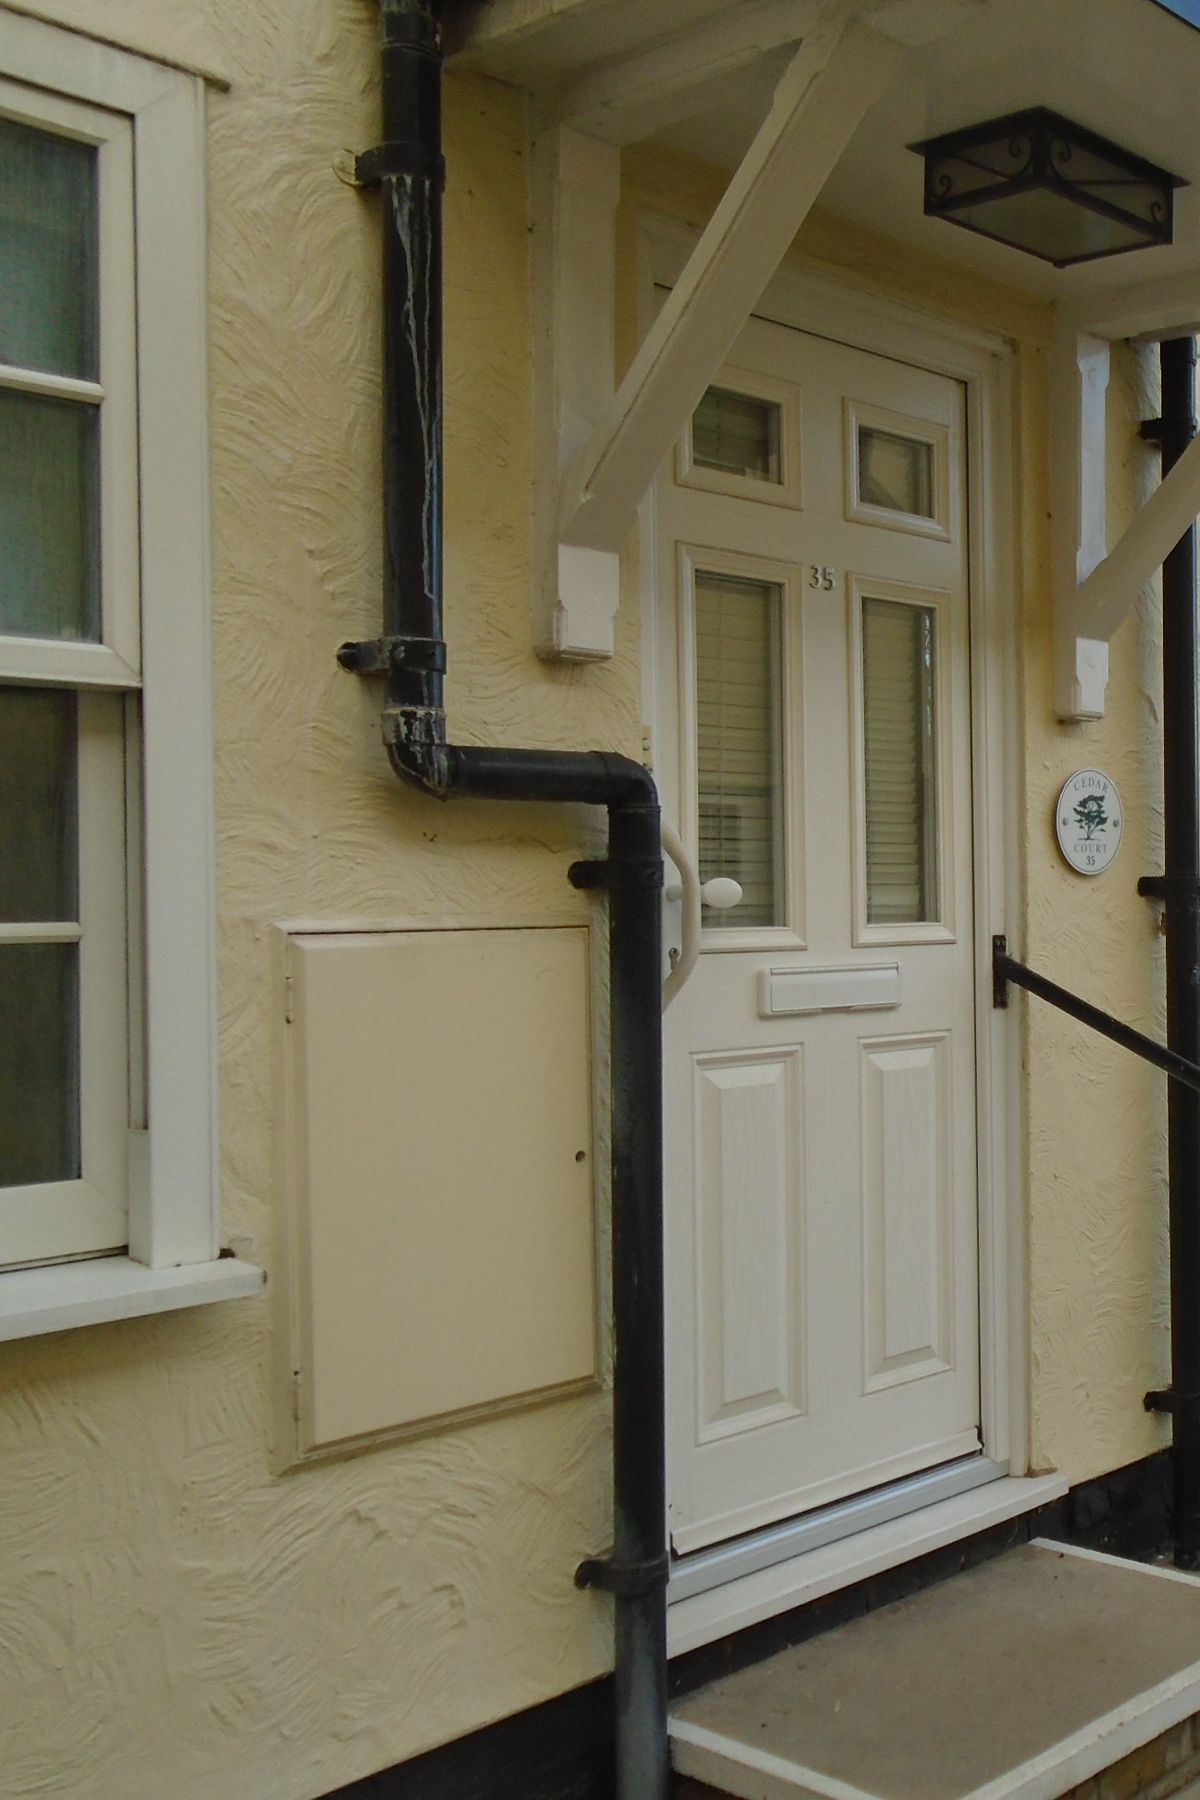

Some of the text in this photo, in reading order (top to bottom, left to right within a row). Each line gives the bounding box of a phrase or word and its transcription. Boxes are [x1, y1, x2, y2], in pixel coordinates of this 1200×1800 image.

[809, 563, 835, 591] 35
[1073, 777, 1109, 793] CEDAR
[1073, 843, 1107, 854] COURT
[1086, 855, 1096, 866] 35
